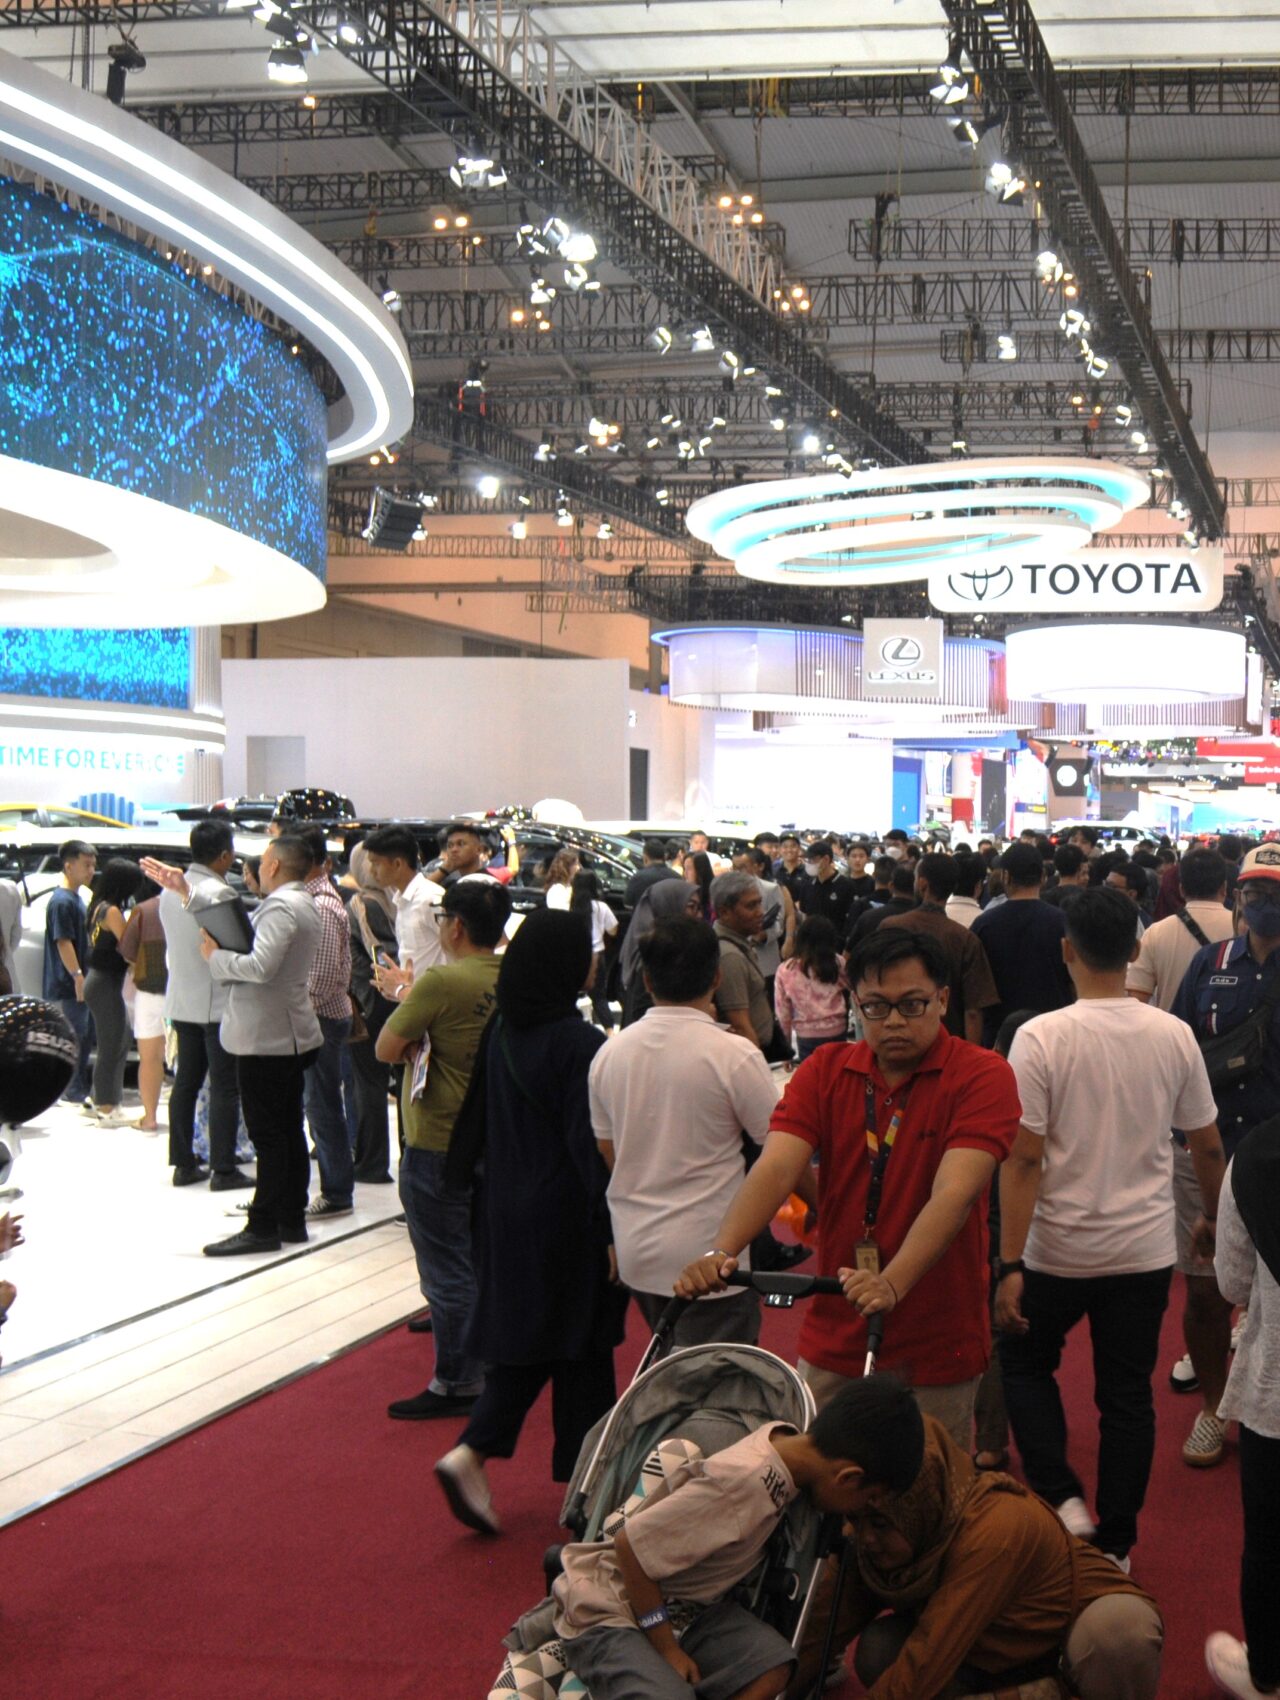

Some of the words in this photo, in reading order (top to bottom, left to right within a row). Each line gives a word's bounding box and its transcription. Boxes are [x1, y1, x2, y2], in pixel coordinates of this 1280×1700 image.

[1021, 563, 1202, 595] TOYOTA
[868, 671, 935, 681] LEXUS
[0, 745, 48, 767] TIME
[55, 749, 96, 768] FOR
[100, 750, 184, 775] EVEROE
